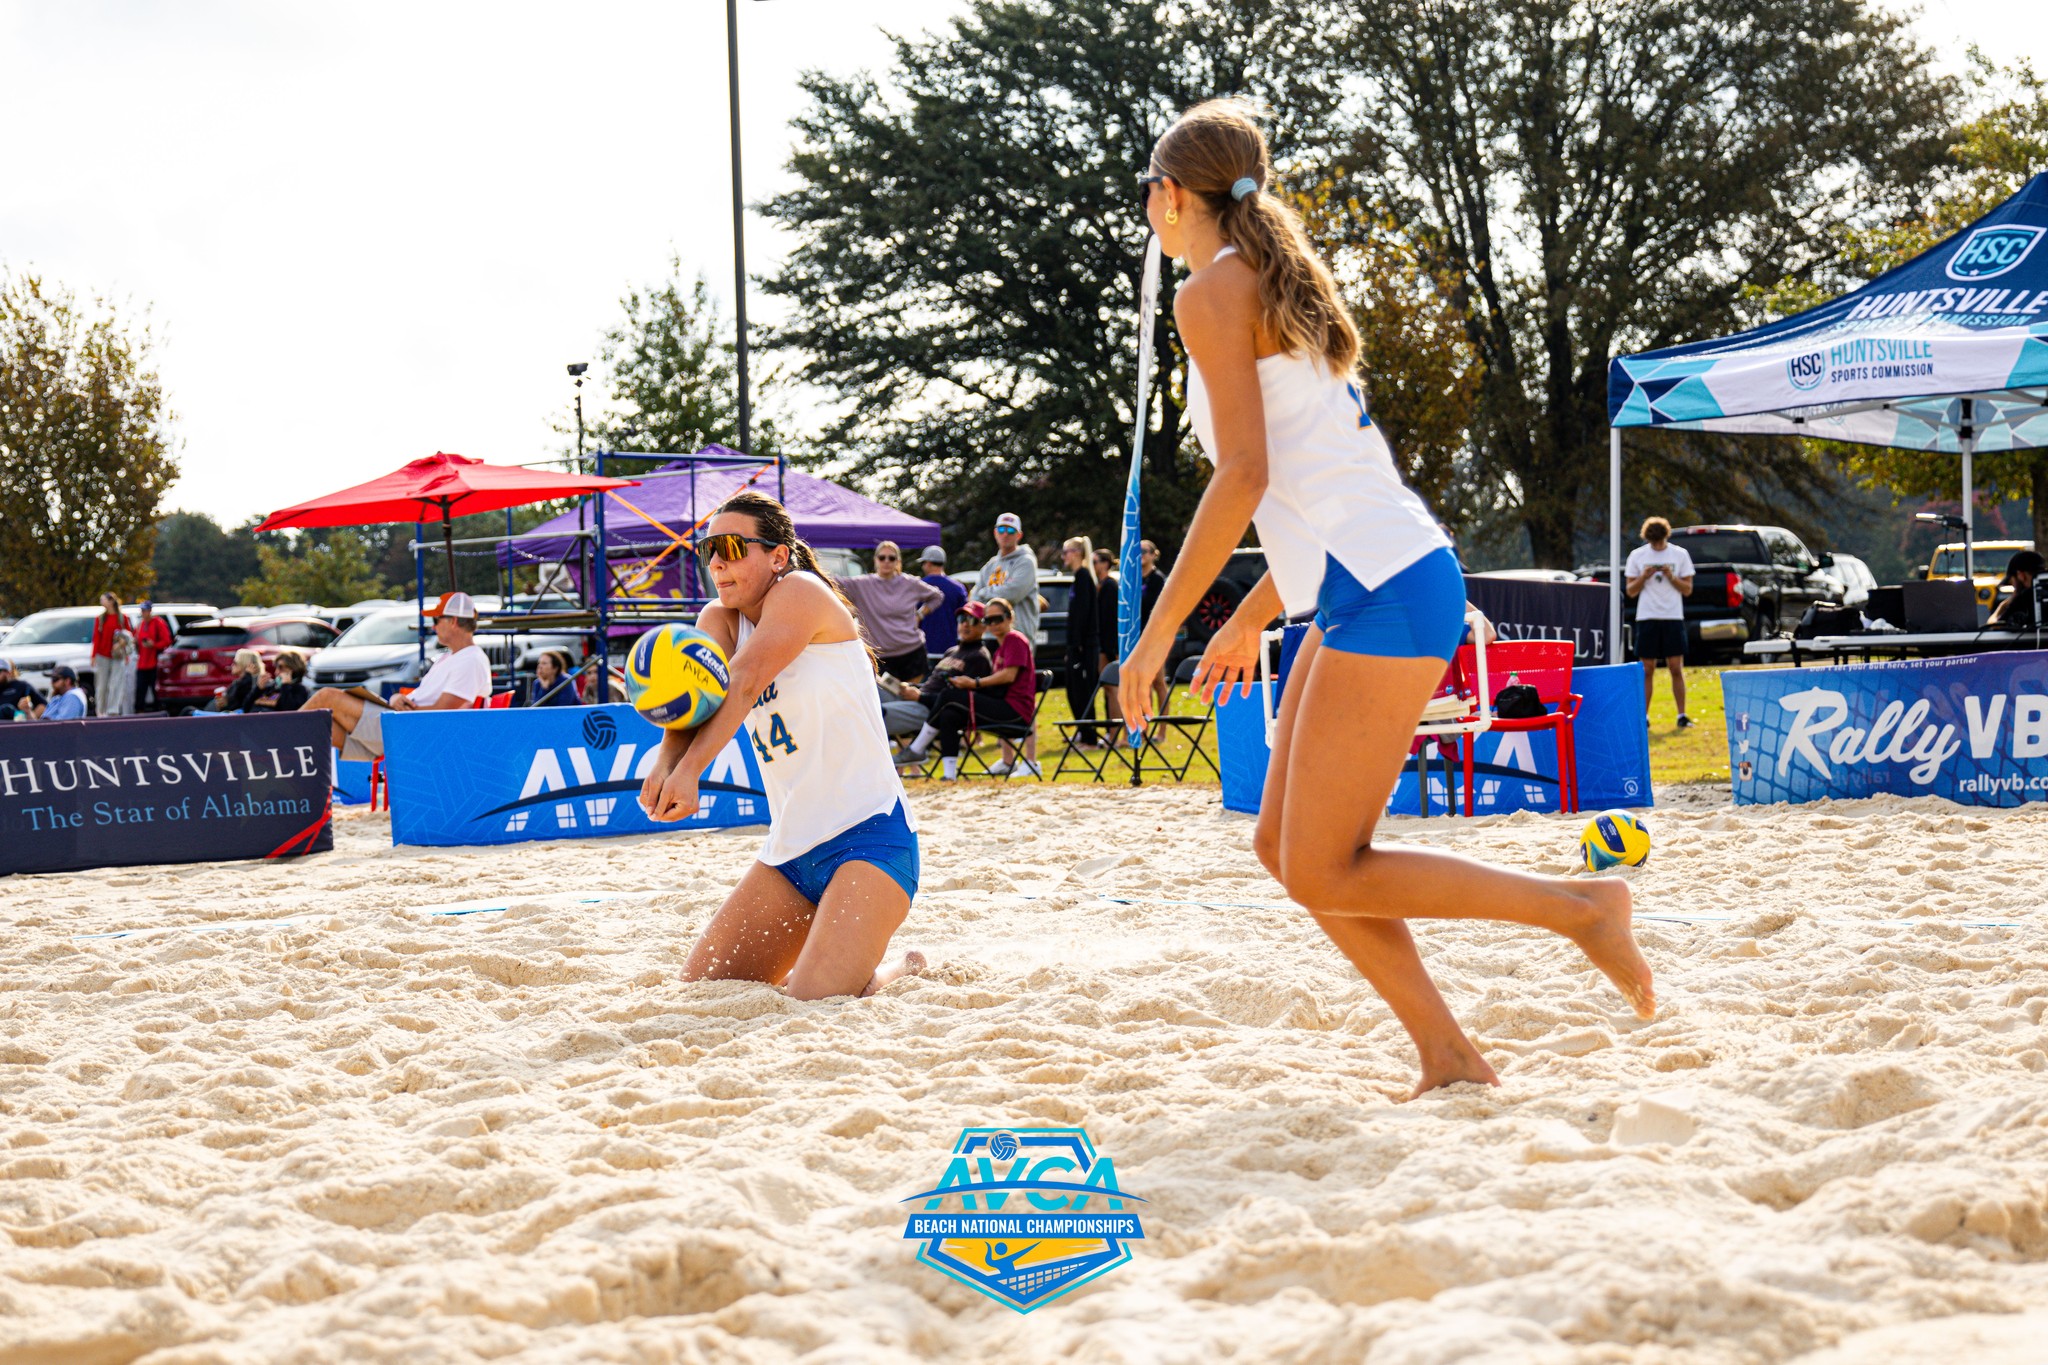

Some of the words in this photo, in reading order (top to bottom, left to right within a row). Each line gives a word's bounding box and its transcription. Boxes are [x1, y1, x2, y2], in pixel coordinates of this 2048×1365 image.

[1957, 236, 2028, 265] HSC
[1845, 287, 2048, 320] HUNTSVILLE
[1791, 352, 1822, 378] HSC
[1831, 338, 1933, 366] HUNTSVILLE
[1831, 366, 1868, 383] SPORTS
[1872, 362, 1934, 379] COMMISSION
[1925, 660, 1943, 669] your
[1946, 657, 1978, 666] partner
[0, 745, 318, 797] HUNTSVILLE
[1959, 773, 2048, 796] rallyvb.co
[22, 805, 84, 832] The
[93, 801, 155, 826] Star
[166, 796, 190, 820] of
[201, 792, 312, 819] Alabama
